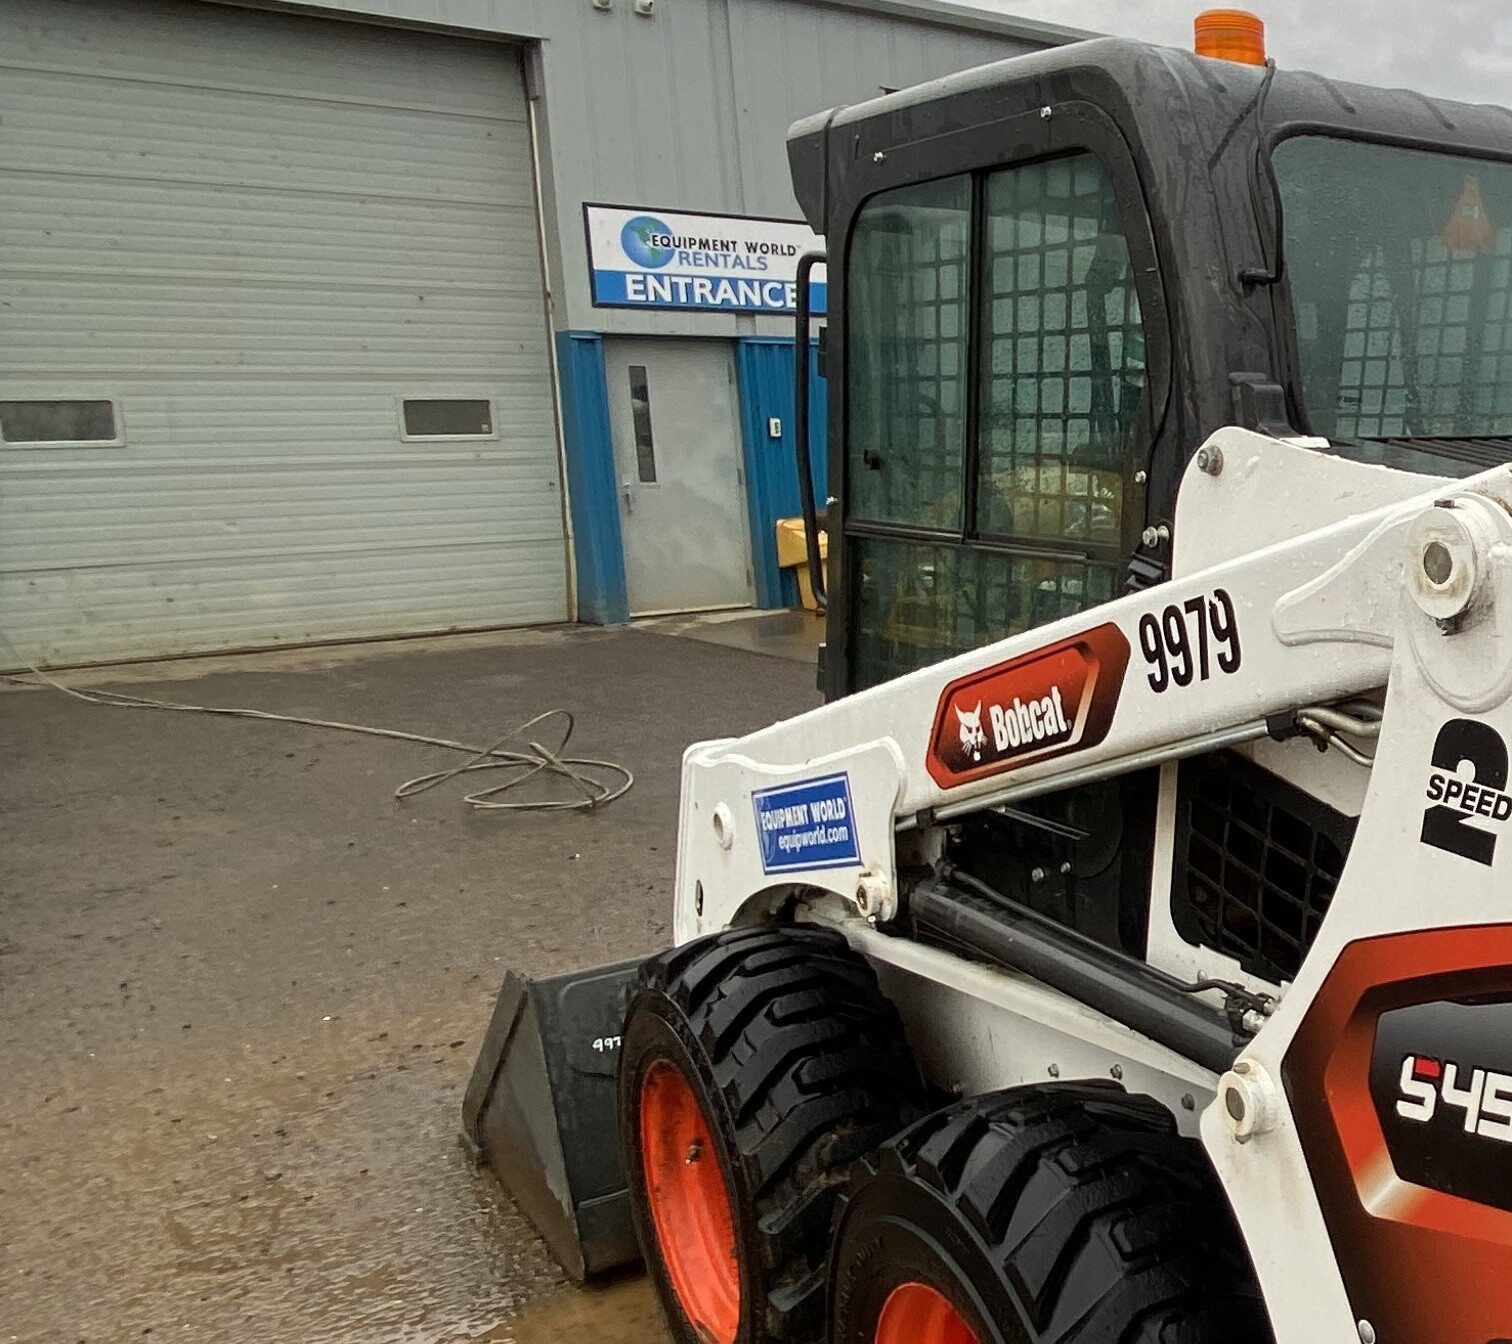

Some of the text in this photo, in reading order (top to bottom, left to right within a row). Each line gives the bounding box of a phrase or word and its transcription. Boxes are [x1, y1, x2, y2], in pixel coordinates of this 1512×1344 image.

[651, 234, 797, 257] EQUIPMENT WORLD
[678, 251, 769, 271] RENTALS
[625, 274, 798, 307] ENTRANCE
[1139, 587, 1242, 694] 9979
[988, 685, 1068, 753] Bobcat
[1420, 718, 1509, 867] 2
[760, 797, 847, 831] EQUIPMENT WORLD
[778, 824, 849, 854] equipworld.com
